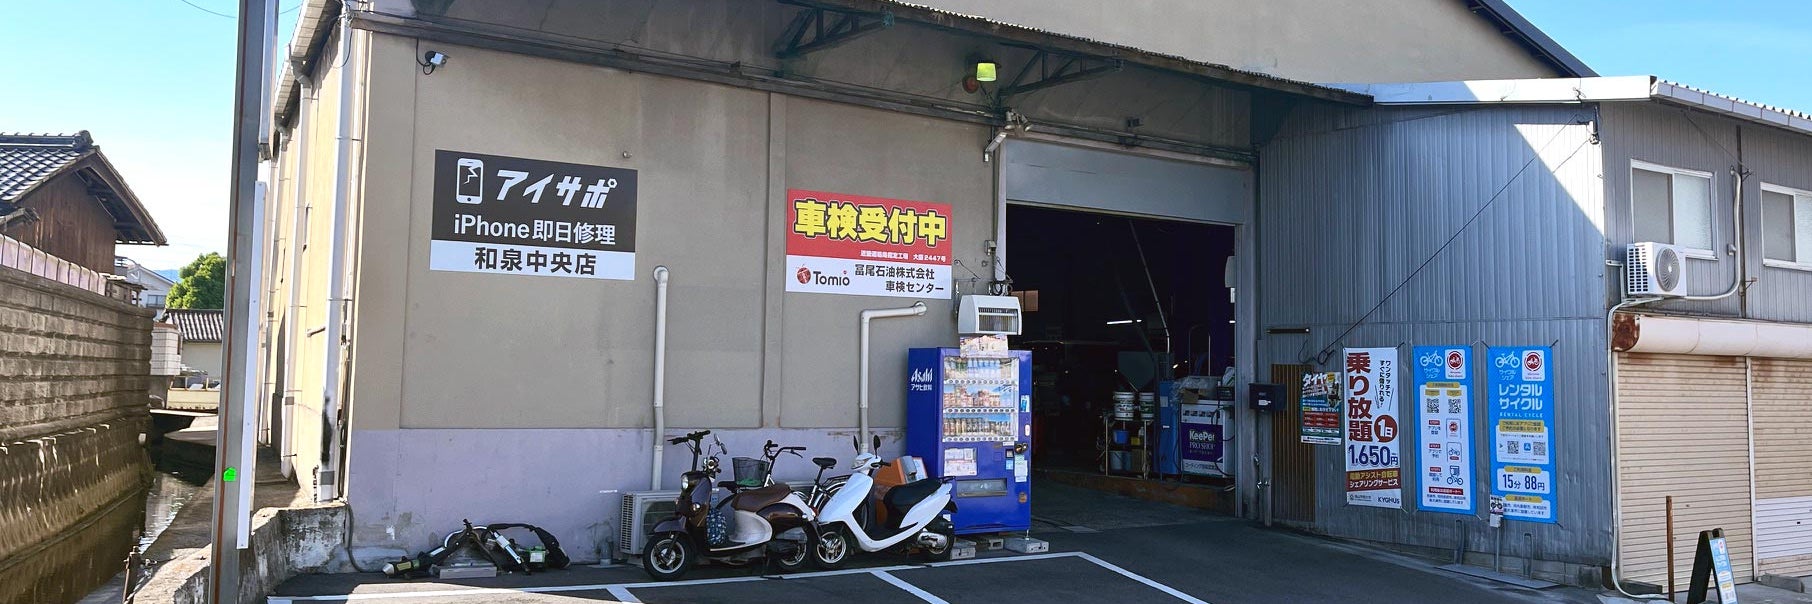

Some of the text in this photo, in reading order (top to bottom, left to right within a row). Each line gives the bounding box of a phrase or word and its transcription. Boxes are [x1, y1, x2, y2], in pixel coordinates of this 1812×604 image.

[496, 169, 618, 209] アイサポ
[795, 199, 947, 247] 車検受付中
[474, 246, 597, 275] 和泉中央店
[813, 271, 850, 287] Tomio
[885, 280, 945, 294] 車検センター
[910, 367, 933, 383] Asahi
[1346, 352, 1374, 442] 乗り放題
[1498, 384, 1543, 397] レンタル
[1498, 397, 1543, 411] サイクル
[1377, 419, 1394, 438] 1日
[1349, 479, 1399, 488] シェアリングサービス
[1502, 474, 1545, 491] 15分 88円
